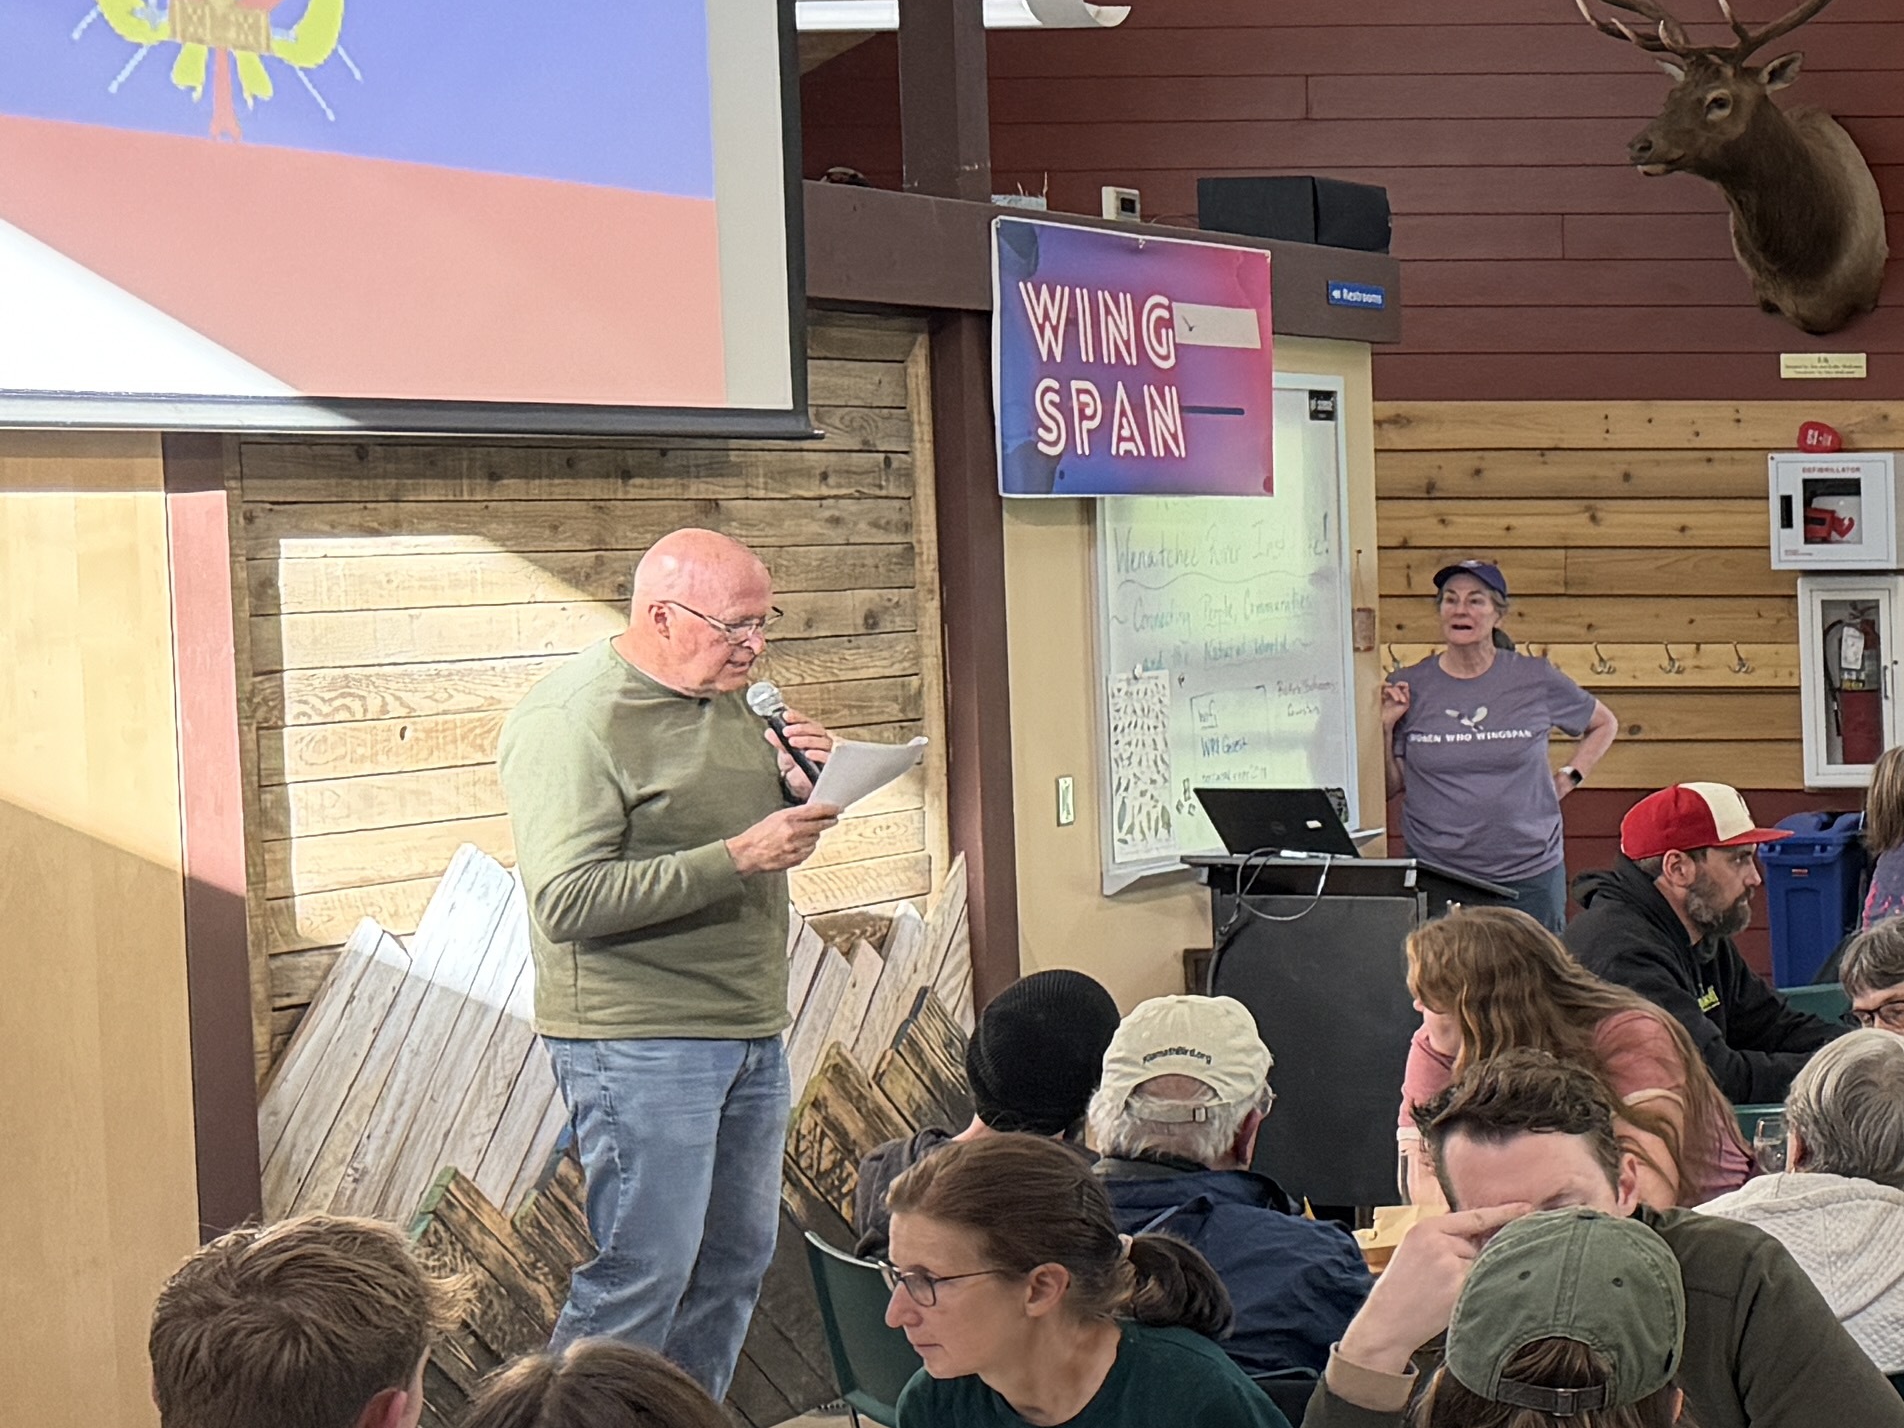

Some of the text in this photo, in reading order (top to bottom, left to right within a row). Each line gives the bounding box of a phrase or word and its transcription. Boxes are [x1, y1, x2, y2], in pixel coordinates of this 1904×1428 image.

[1019, 281, 1176, 369] WING
[1035, 378, 1186, 458] SPAN
[1445, 734, 1472, 742] WHO
[1476, 729, 1532, 740] WINGSPAN
